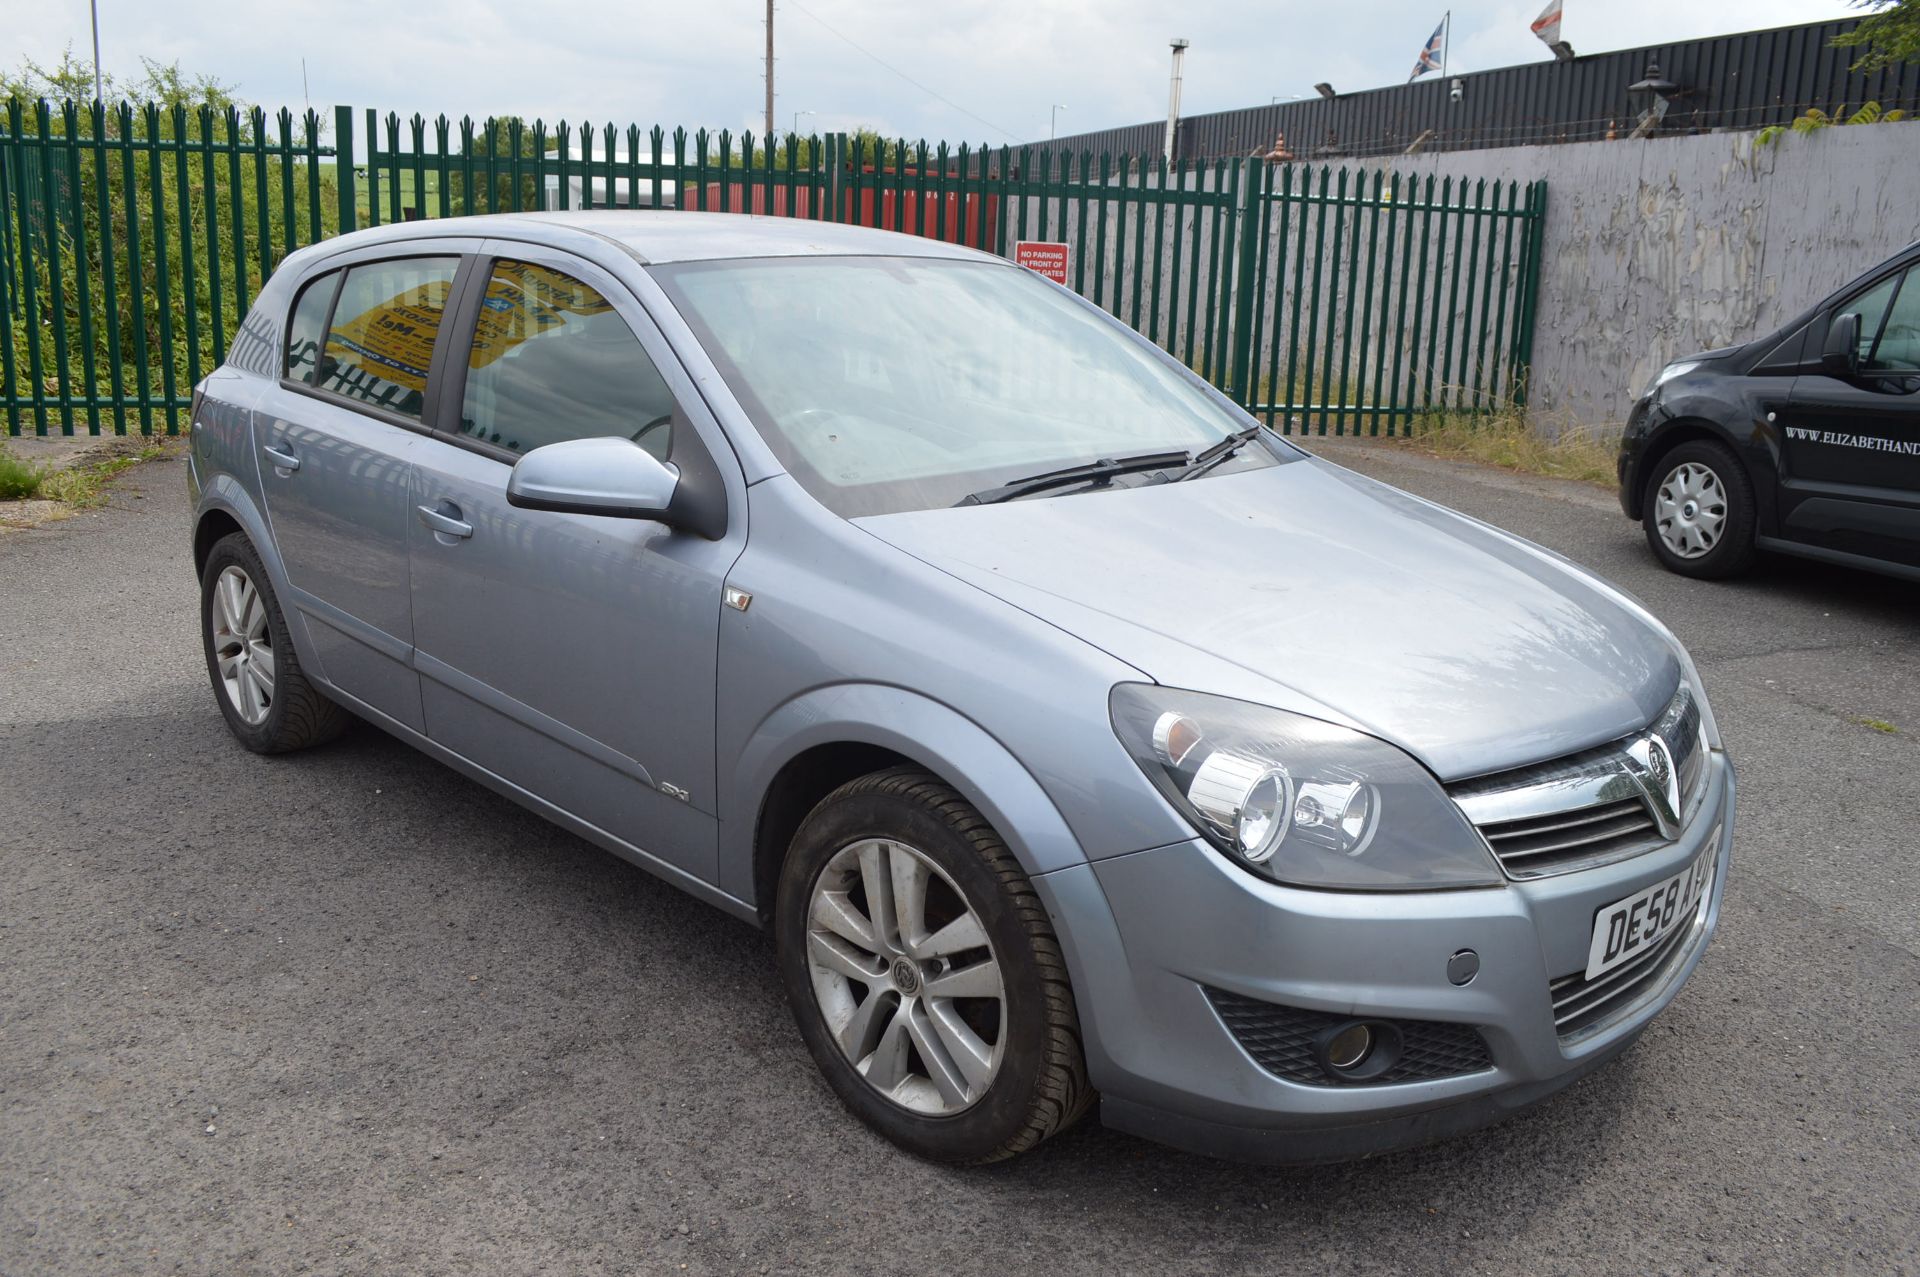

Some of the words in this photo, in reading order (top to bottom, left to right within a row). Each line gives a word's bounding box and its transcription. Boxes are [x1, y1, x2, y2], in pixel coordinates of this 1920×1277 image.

[1021, 250, 1031, 258] NO
[1033, 251, 1063, 260] PARKING
[1042, 269, 1064, 277] GATES
[1602, 878, 1680, 965] DE58
